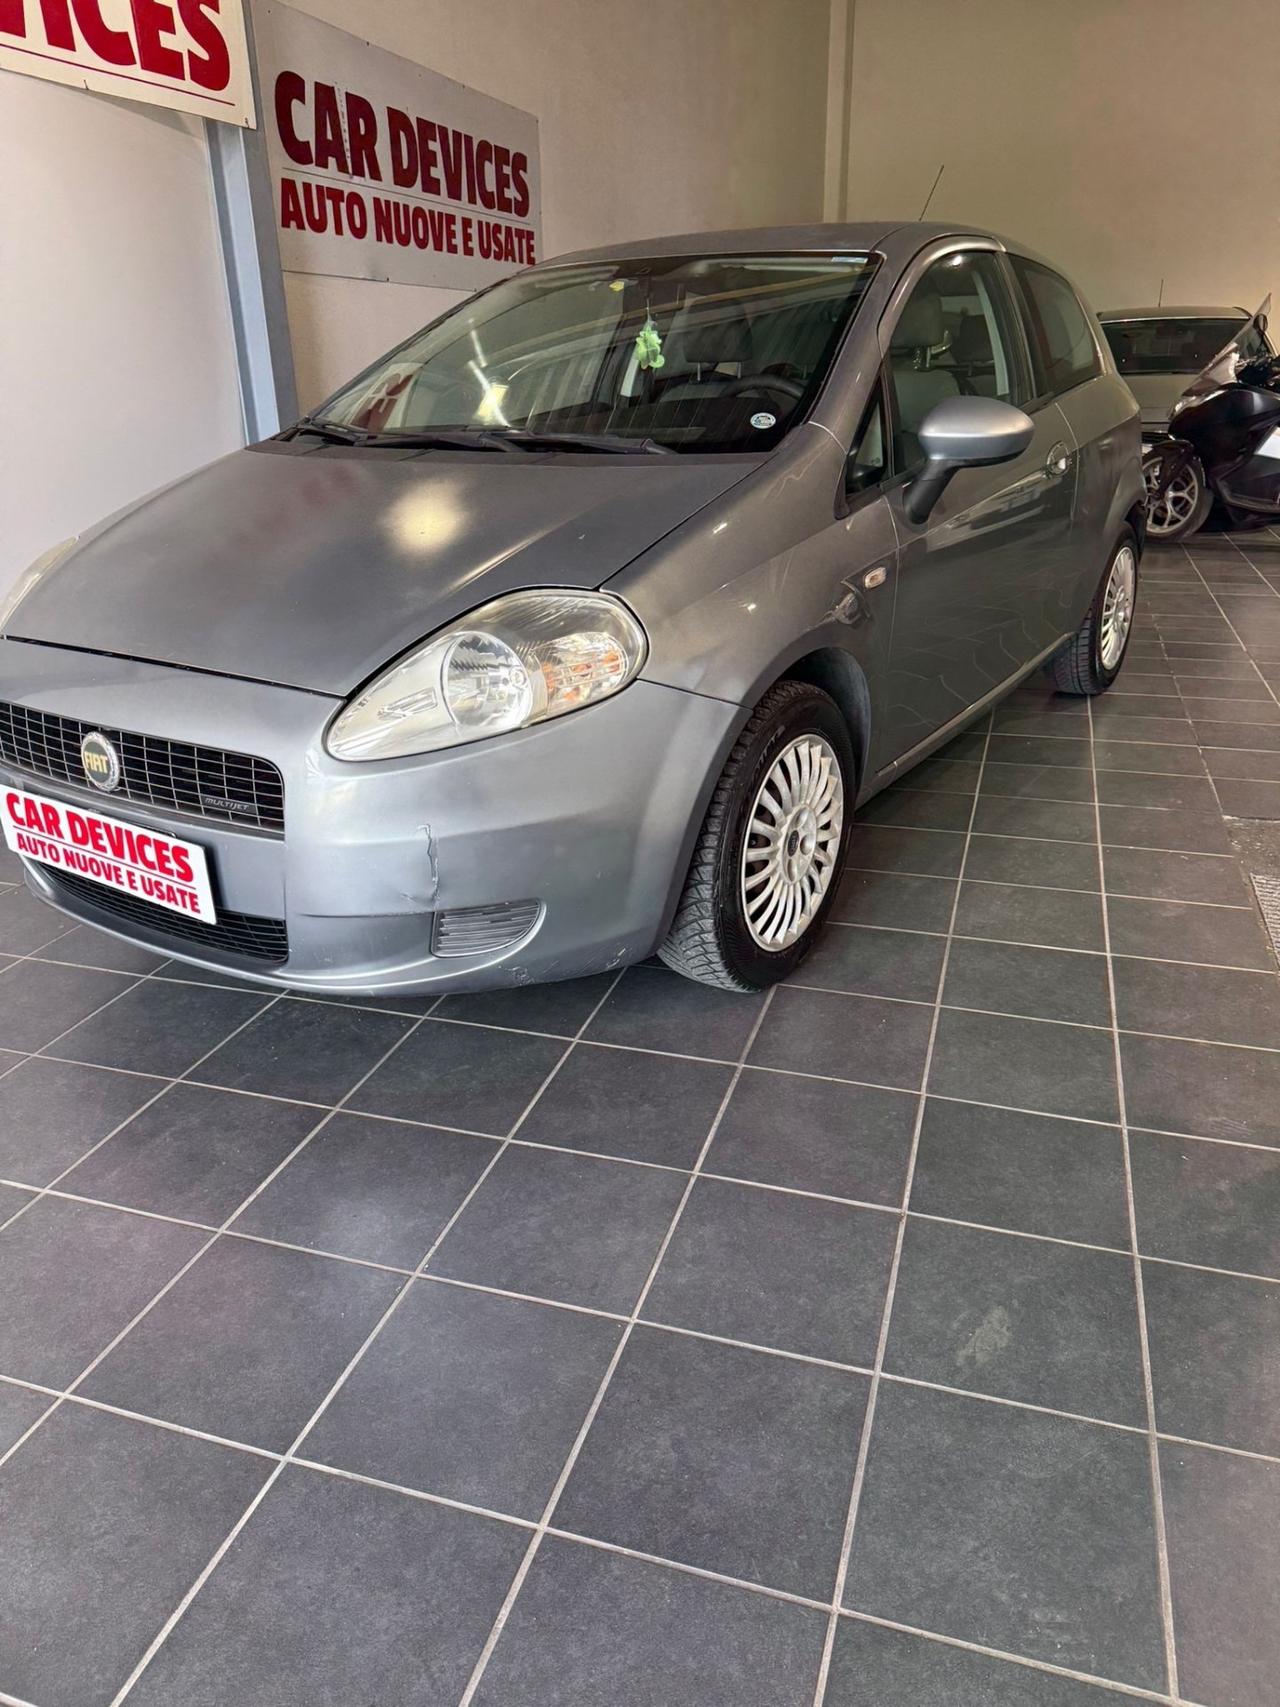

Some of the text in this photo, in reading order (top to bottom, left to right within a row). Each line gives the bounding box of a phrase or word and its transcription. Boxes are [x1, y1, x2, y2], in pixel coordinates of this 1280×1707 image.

[0, 0, 232, 92] CES
[274, 71, 530, 218] CAR DEVICES
[280, 178, 535, 266] AUTO NUOVE E USATE
[83, 751, 109, 774] FIAT
[6, 792, 194, 883] CAR DEVICES
[16, 832, 201, 914] AUTO NUOVE E USATE
